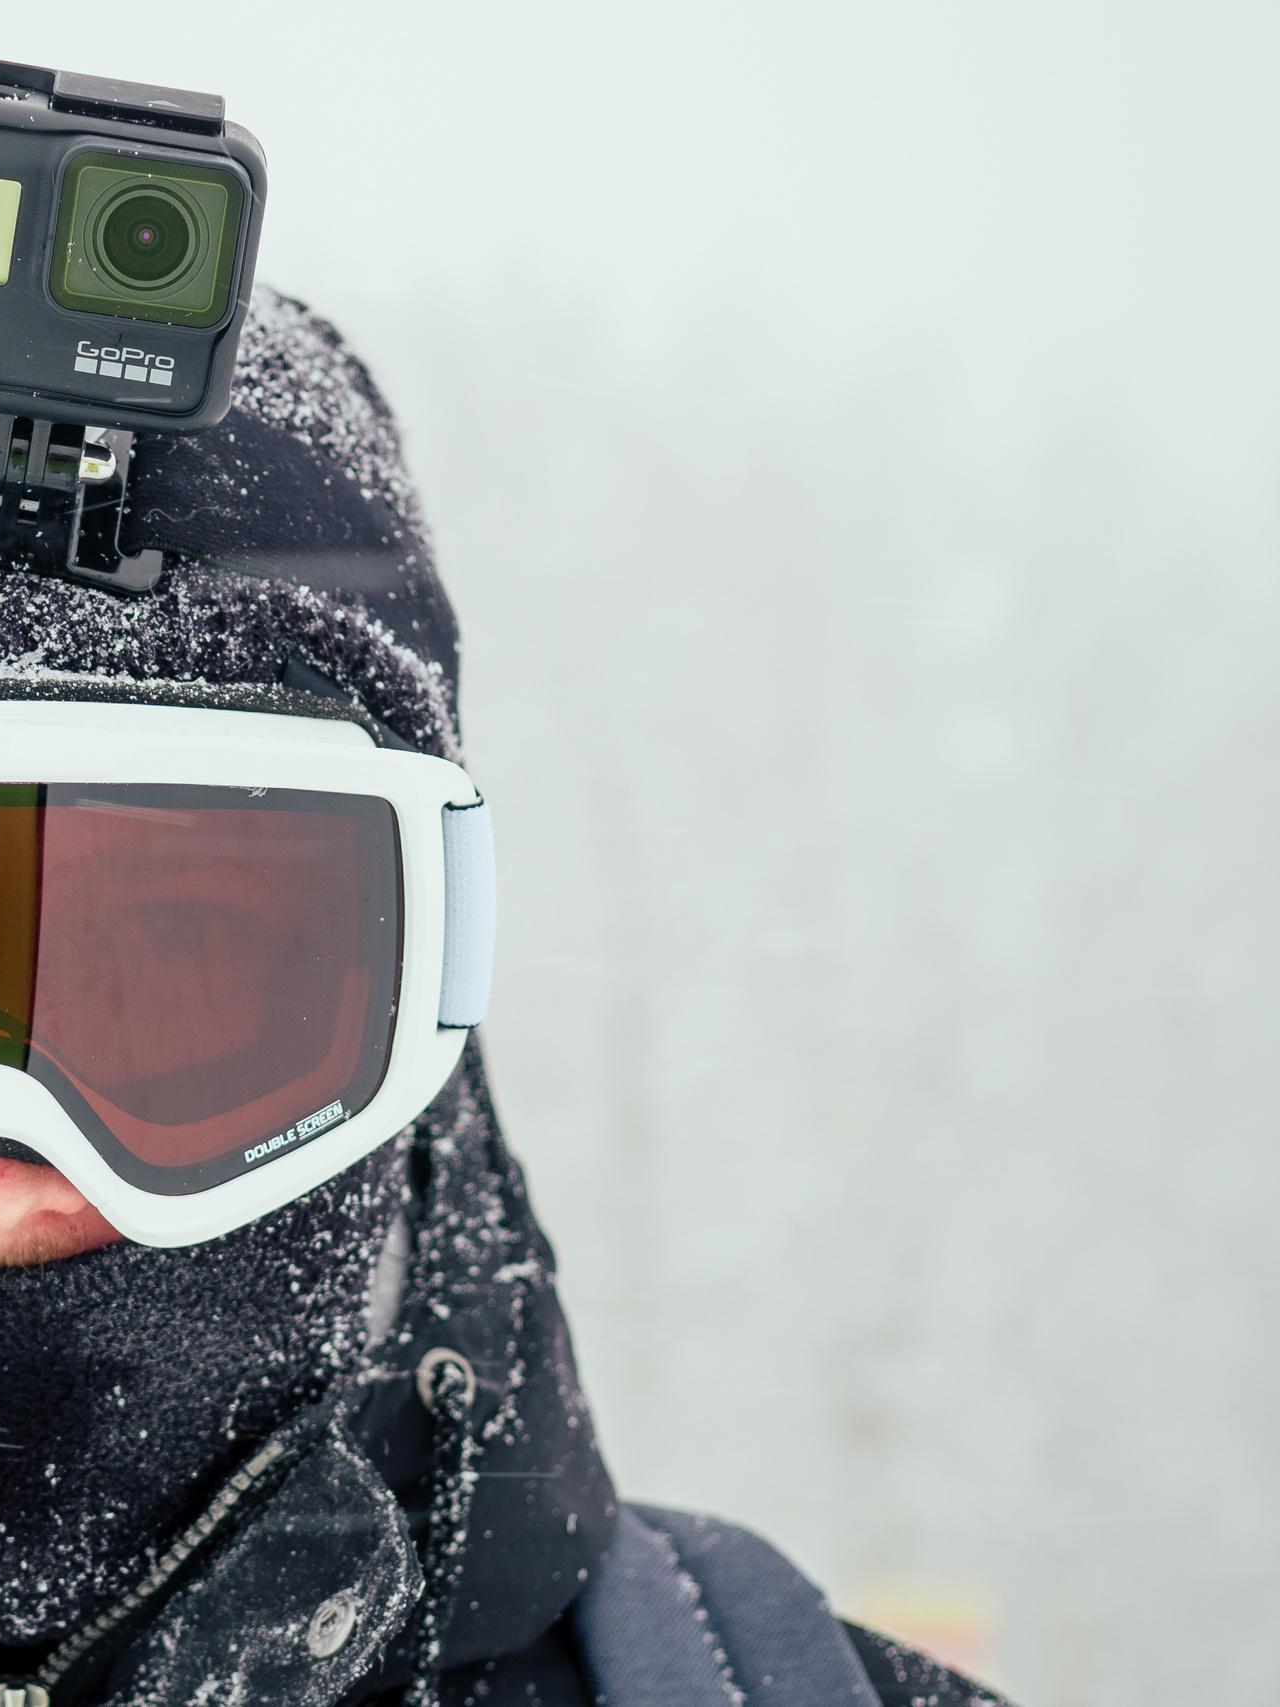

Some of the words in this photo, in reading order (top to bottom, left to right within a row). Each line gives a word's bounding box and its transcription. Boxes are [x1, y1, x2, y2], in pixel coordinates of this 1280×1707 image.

[76, 340, 175, 369] GoPro
[244, 1128, 297, 1163] DOUBLE
[296, 1102, 343, 1137] SCREEN
